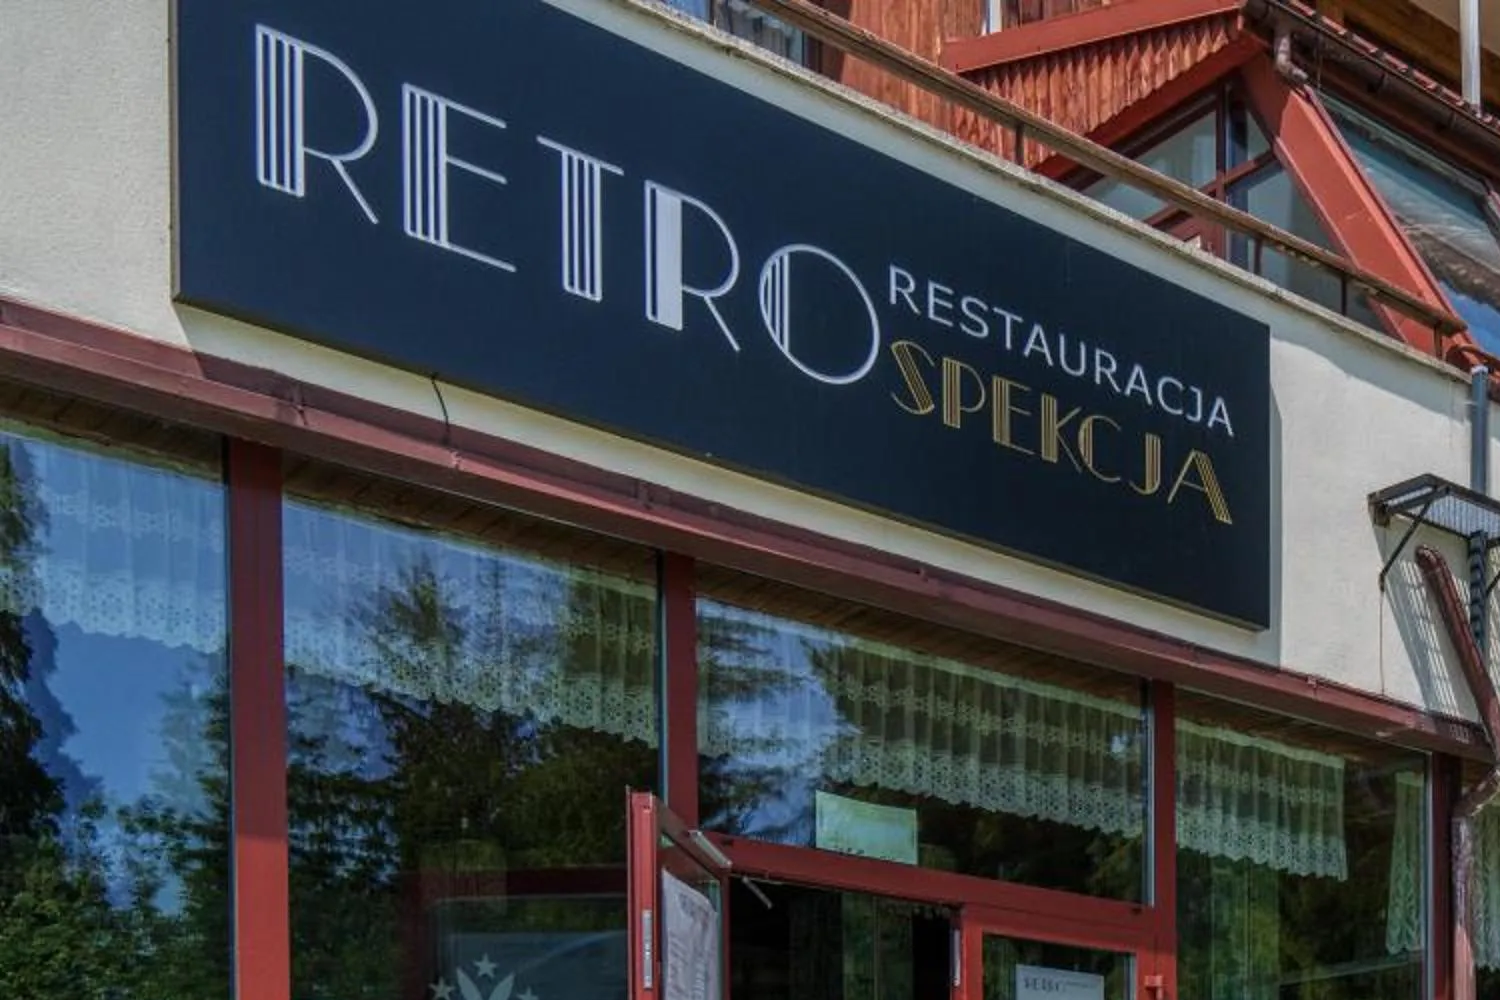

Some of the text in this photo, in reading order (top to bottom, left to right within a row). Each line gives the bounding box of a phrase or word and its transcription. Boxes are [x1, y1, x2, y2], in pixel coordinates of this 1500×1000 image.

[254, 23, 881, 386] RETRO
[888, 264, 1236, 439] RESTAURACJA
[888, 339, 1234, 526] SPEKCJA
